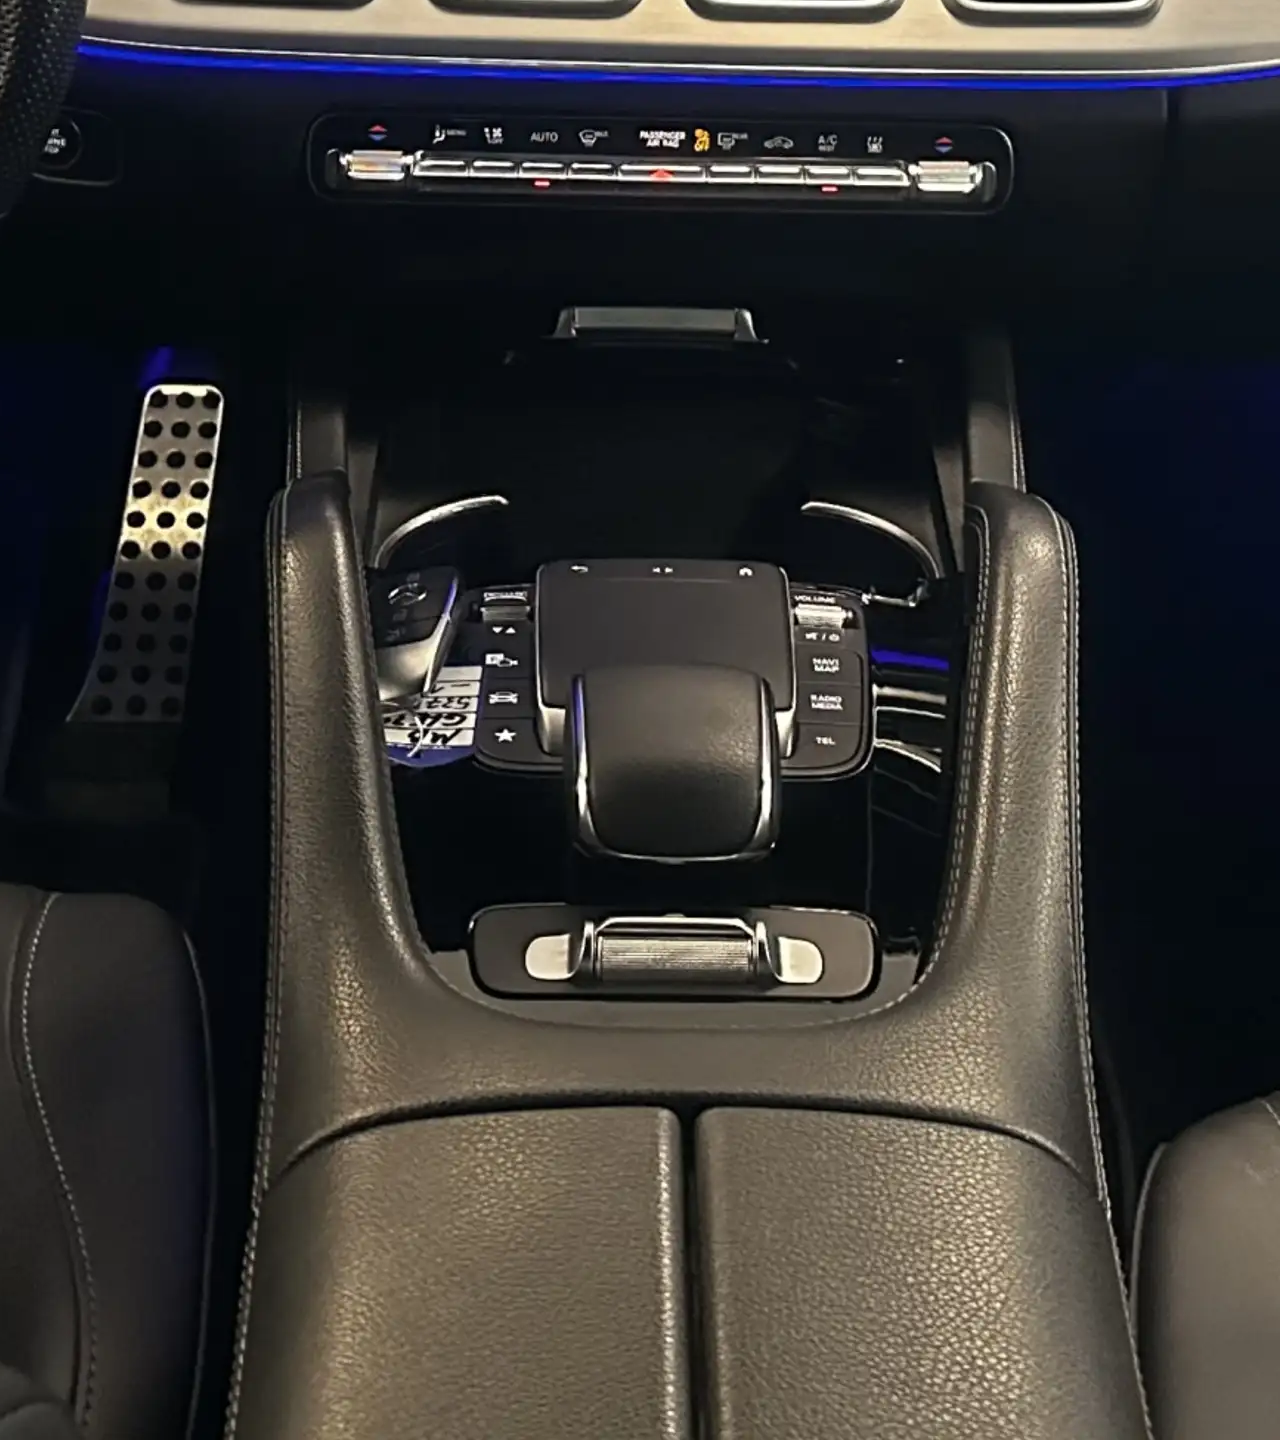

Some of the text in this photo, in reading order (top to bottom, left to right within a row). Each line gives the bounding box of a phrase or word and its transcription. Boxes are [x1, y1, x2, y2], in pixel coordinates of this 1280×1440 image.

[530, 131, 559, 143] AUTO
[818, 134, 838, 146] A/C
[794, 594, 836, 605] VOLUME
[810, 693, 842, 703] RADIO
[815, 736, 836, 746] TEL
